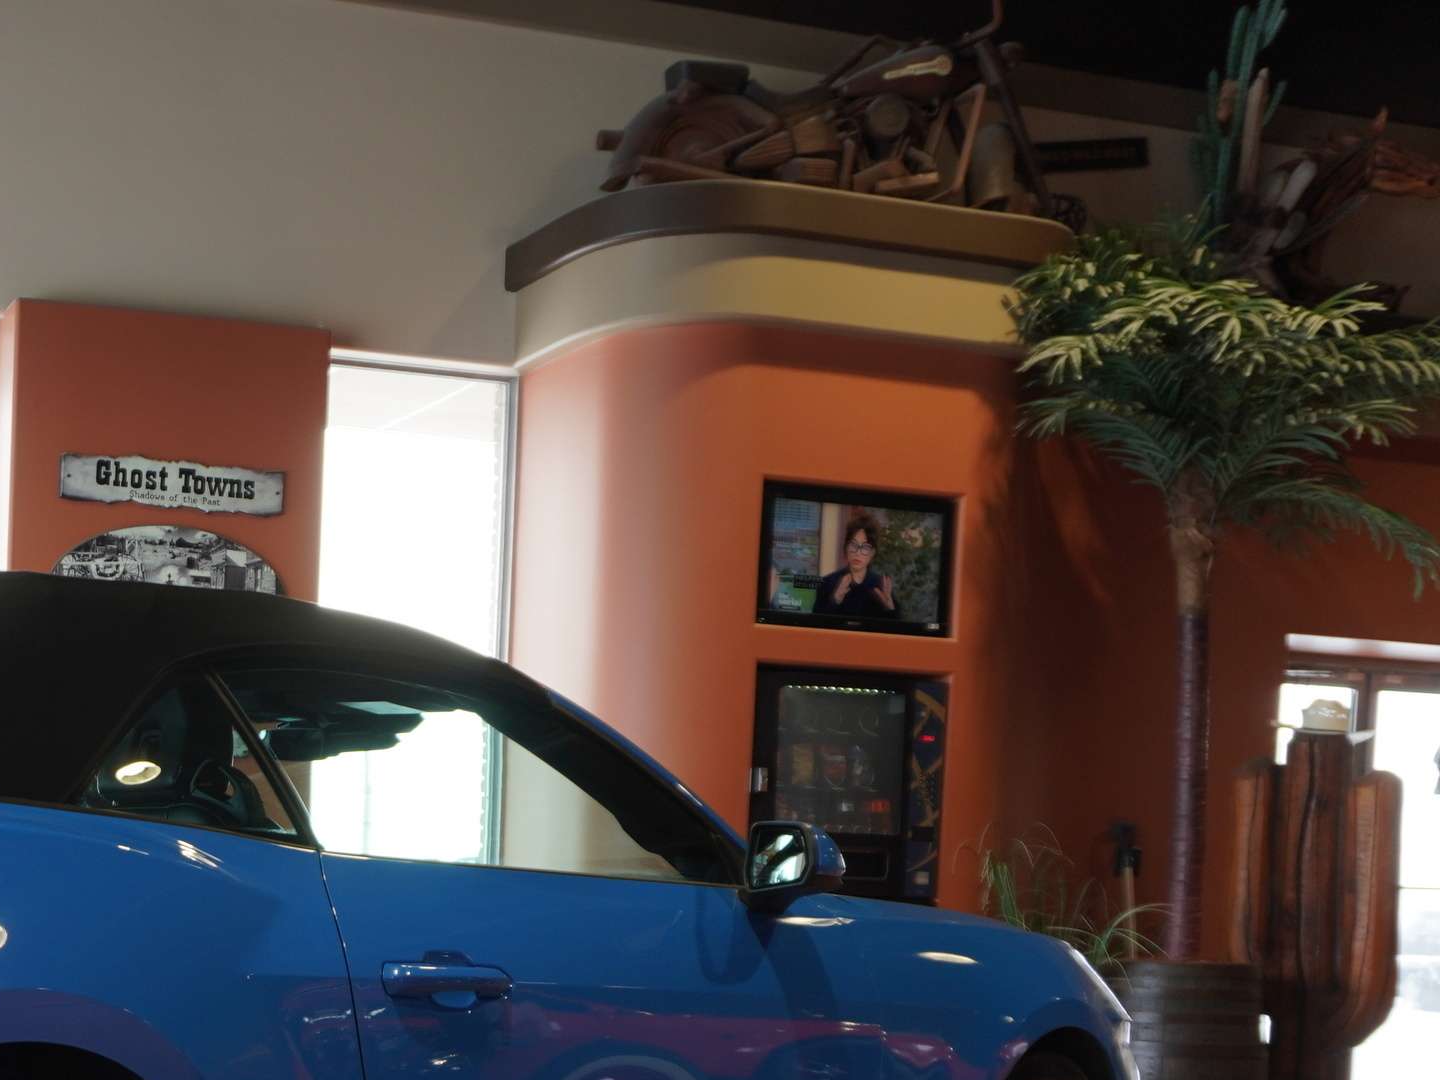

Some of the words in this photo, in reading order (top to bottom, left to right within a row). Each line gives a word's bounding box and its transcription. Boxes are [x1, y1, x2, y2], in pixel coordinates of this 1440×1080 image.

[95, 459, 169, 492] Ghost
[179, 468, 256, 500] Towns
[129, 489, 165, 500] Shadows
[169, 494, 178, 502] of
[183, 495, 197, 504] the
[202, 496, 222, 506] Past
